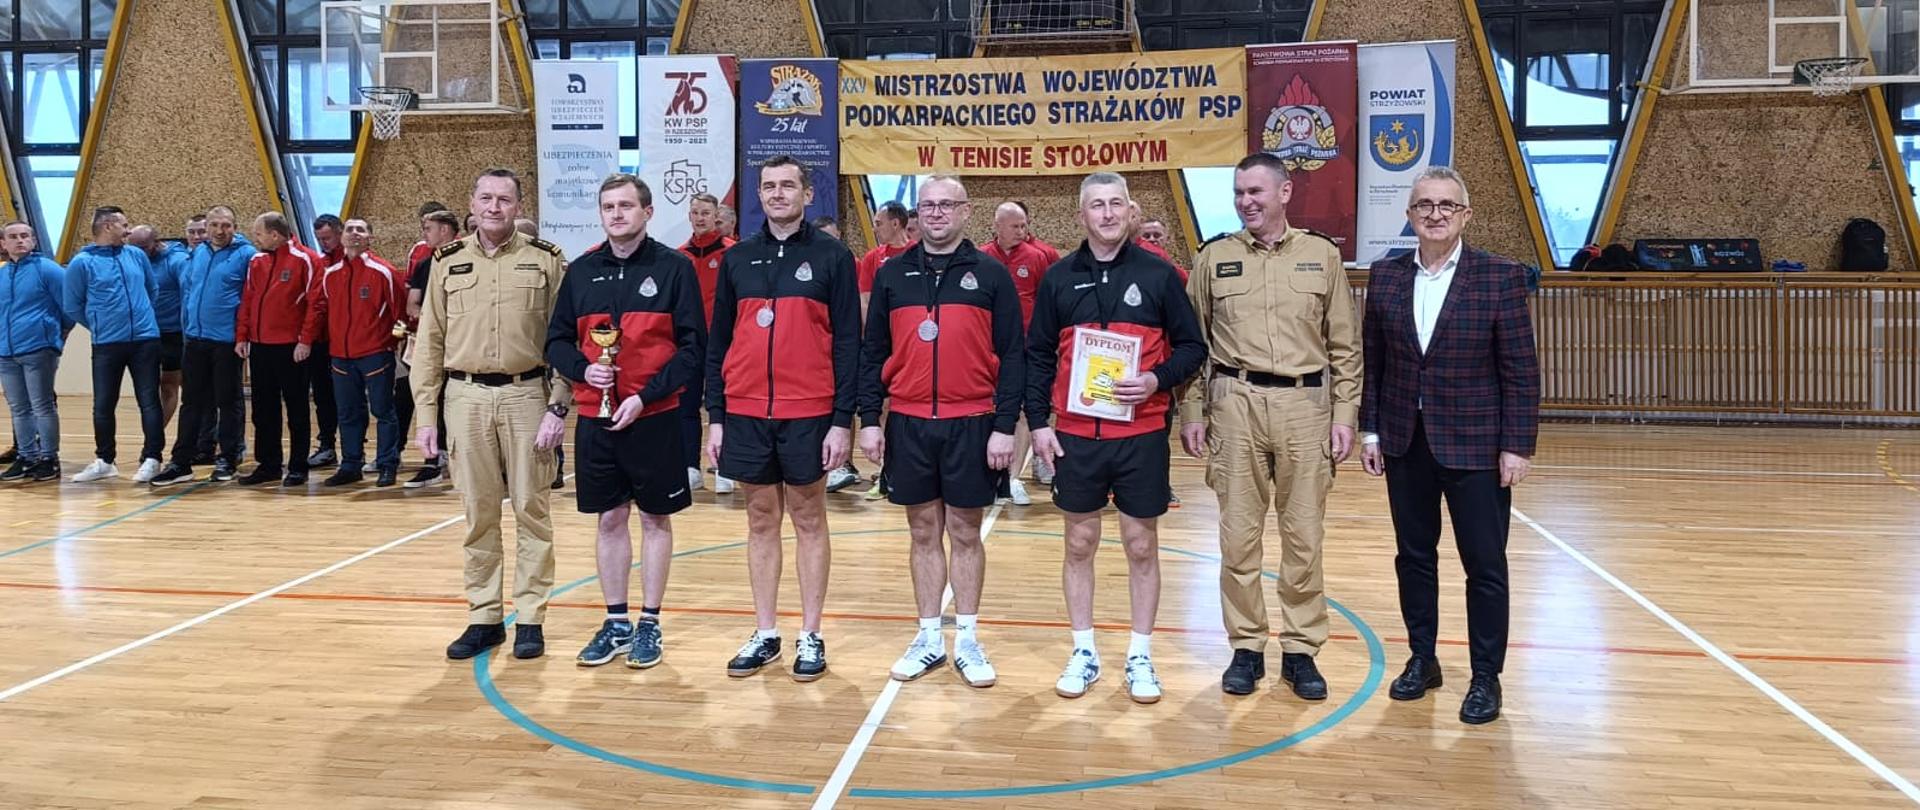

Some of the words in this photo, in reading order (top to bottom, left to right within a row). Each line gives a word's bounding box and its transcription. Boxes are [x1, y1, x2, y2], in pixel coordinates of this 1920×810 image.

[841, 77, 867, 94] XXV
[874, 72, 1027, 96] MISTRZOSTWA
[1043, 61, 1217, 93] WOJEWÓDZTWA
[664, 72, 708, 116] 75
[1370, 89, 1427, 100] POWIAT
[845, 102, 1036, 127] PODKARPACKIEGO
[1048, 92, 1185, 125] STRAŻAKÓW
[1199, 95, 1242, 119] PSP
[664, 118, 683, 128] KW
[686, 117, 708, 128] PSP
[770, 117, 790, 132] 25
[790, 117, 808, 133] lat
[543, 151, 613, 159] UBEZPIECZENIA
[917, 146, 936, 168] W
[950, 146, 1033, 169] TENISIE
[1043, 139, 1168, 168] STOŁOWYM
[663, 178, 708, 194] KSRG
[1085, 337, 1131, 353] DYPLOM
